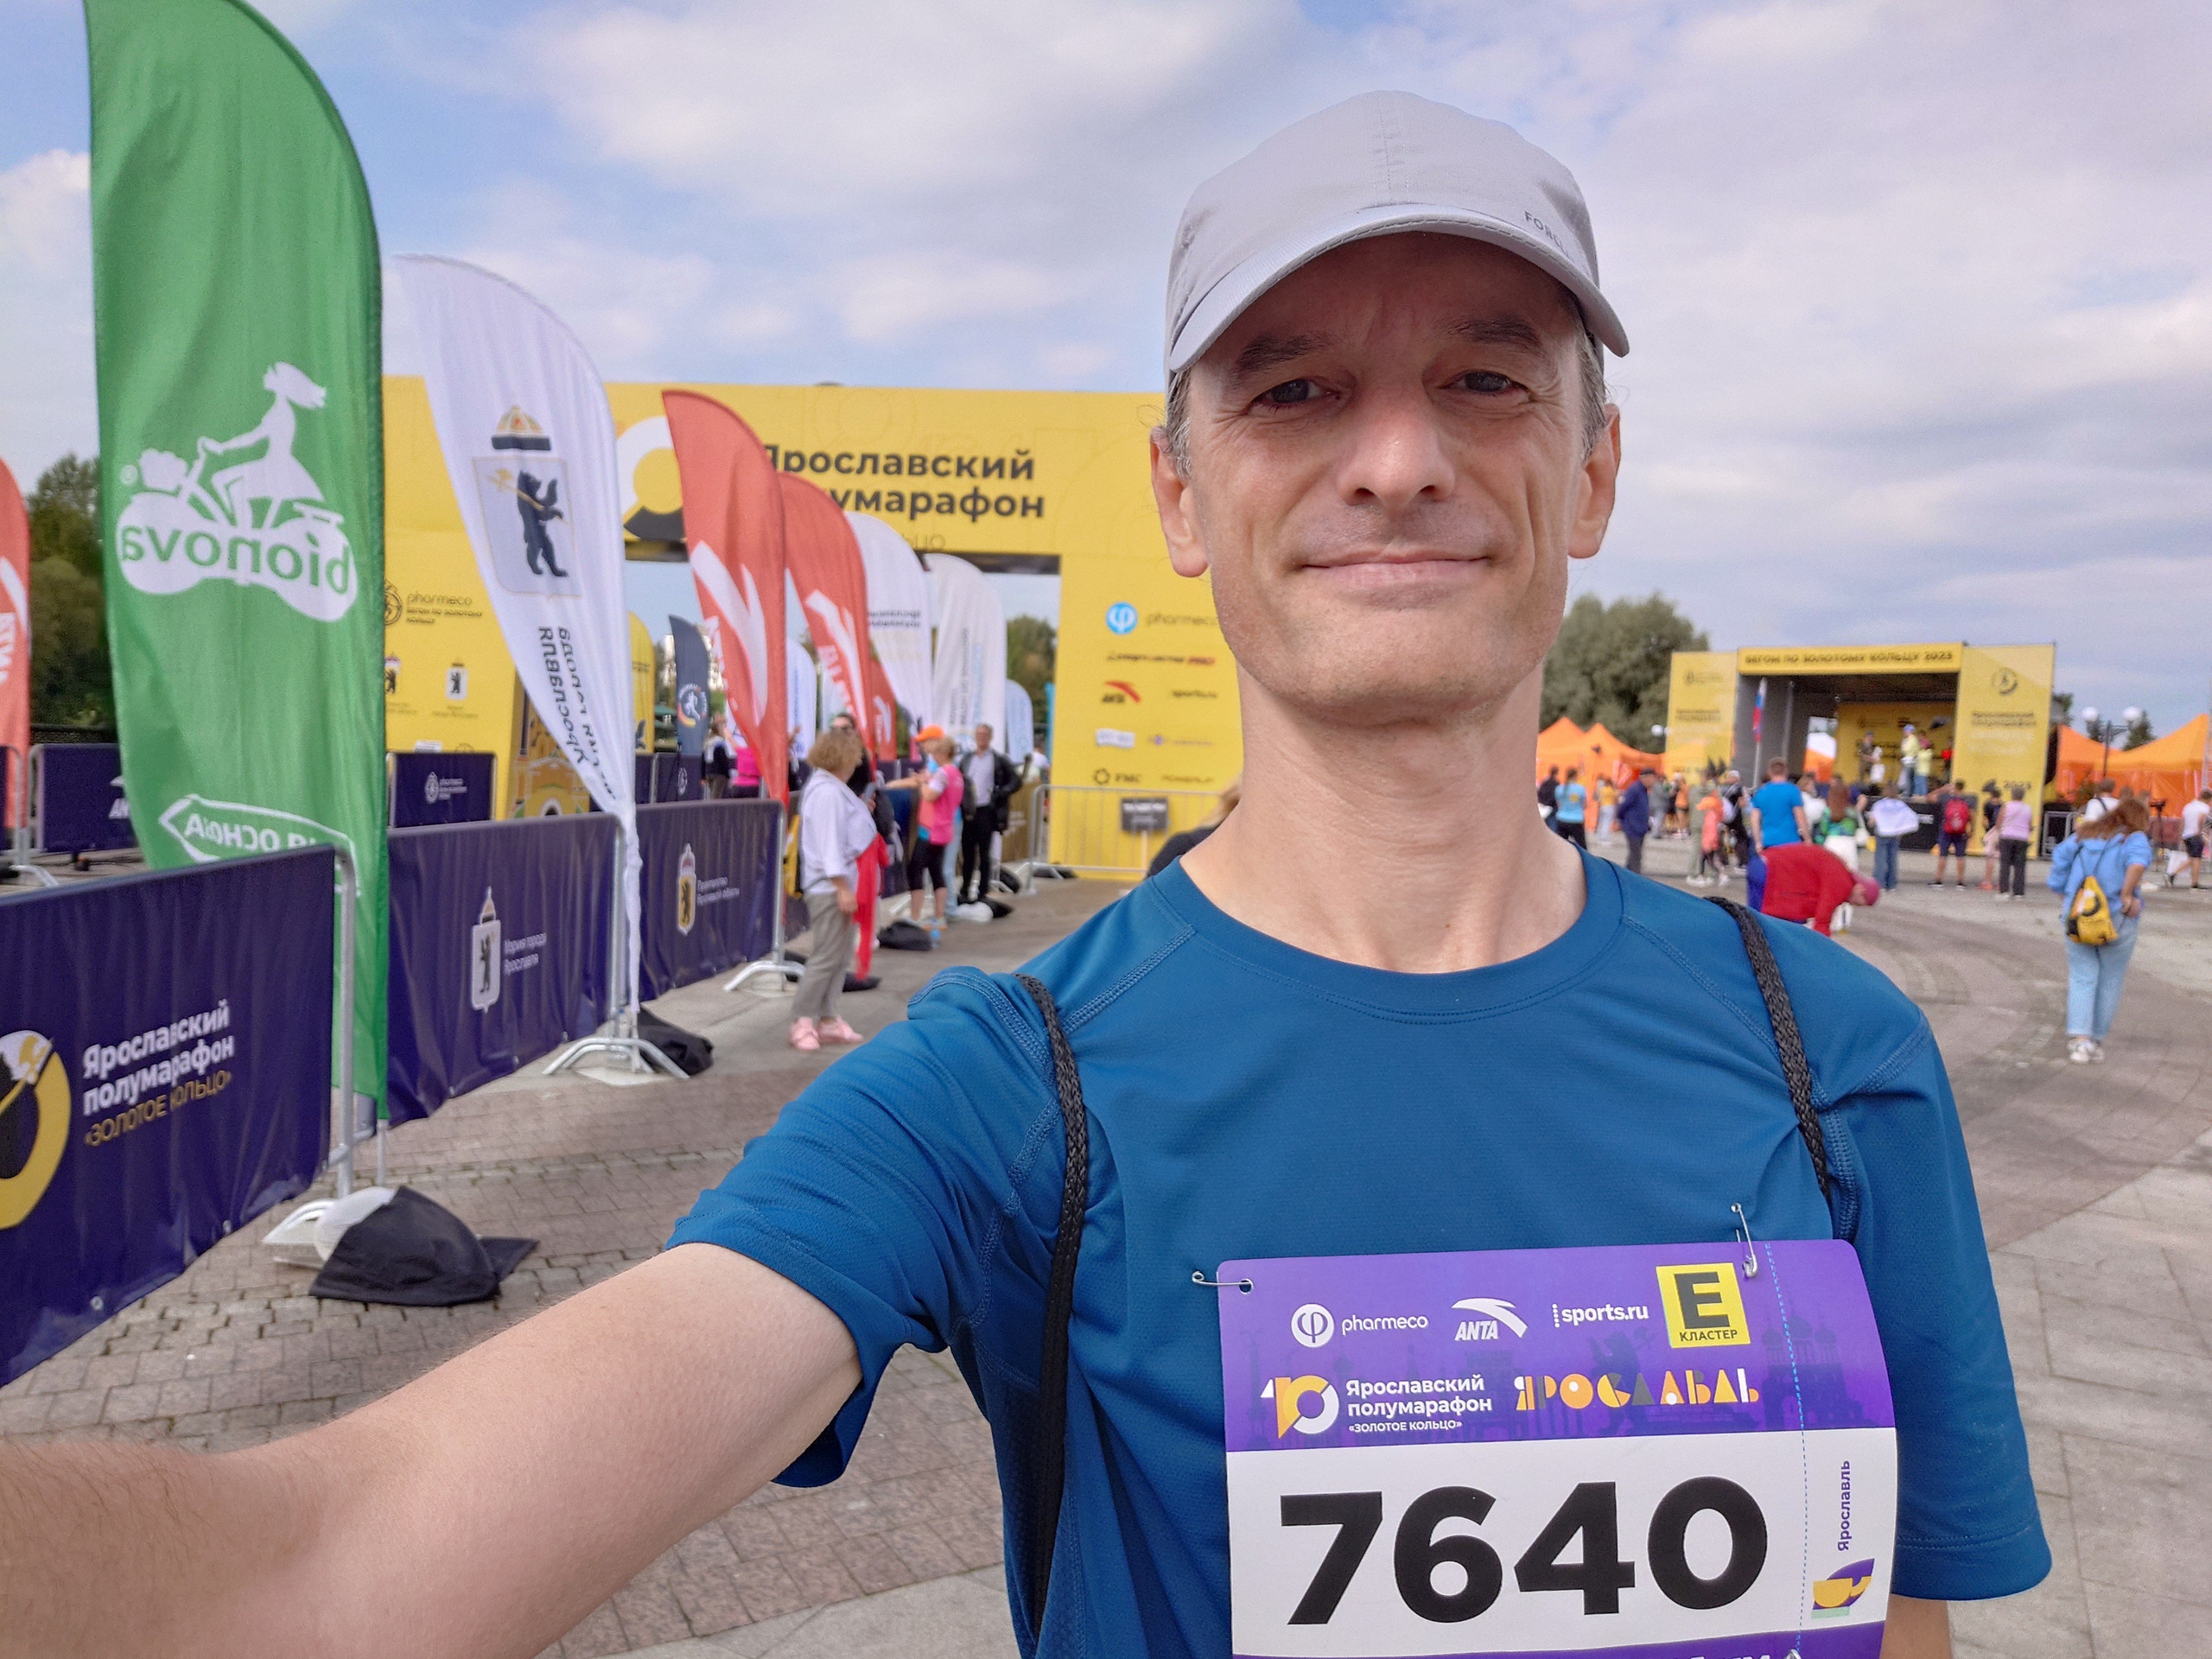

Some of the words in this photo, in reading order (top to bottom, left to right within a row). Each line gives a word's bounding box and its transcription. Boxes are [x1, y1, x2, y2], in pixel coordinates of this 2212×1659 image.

[830, 486, 1046, 523] умарафон
[83, 999, 230, 1079] Ярославский
[84, 1035, 235, 1116] полумарафон
[1342, 1314, 1429, 1336] pharmeco
[1561, 1304, 1649, 1326] sports.ru
[1454, 1320, 1499, 1341] ANTA
[1680, 1329, 1738, 1342] КЛАСТЕР
[1345, 1374, 1485, 1399] Ярославский
[1347, 1397, 1493, 1419] полумарафон
[1349, 1422, 1408, 1433] «ЗОЛОТОЕ
[1409, 1420, 1463, 1431] КОЛЬЦО»
[1837, 1460, 1853, 1551] Ярославль
[1281, 1475, 1768, 1624] 7640
